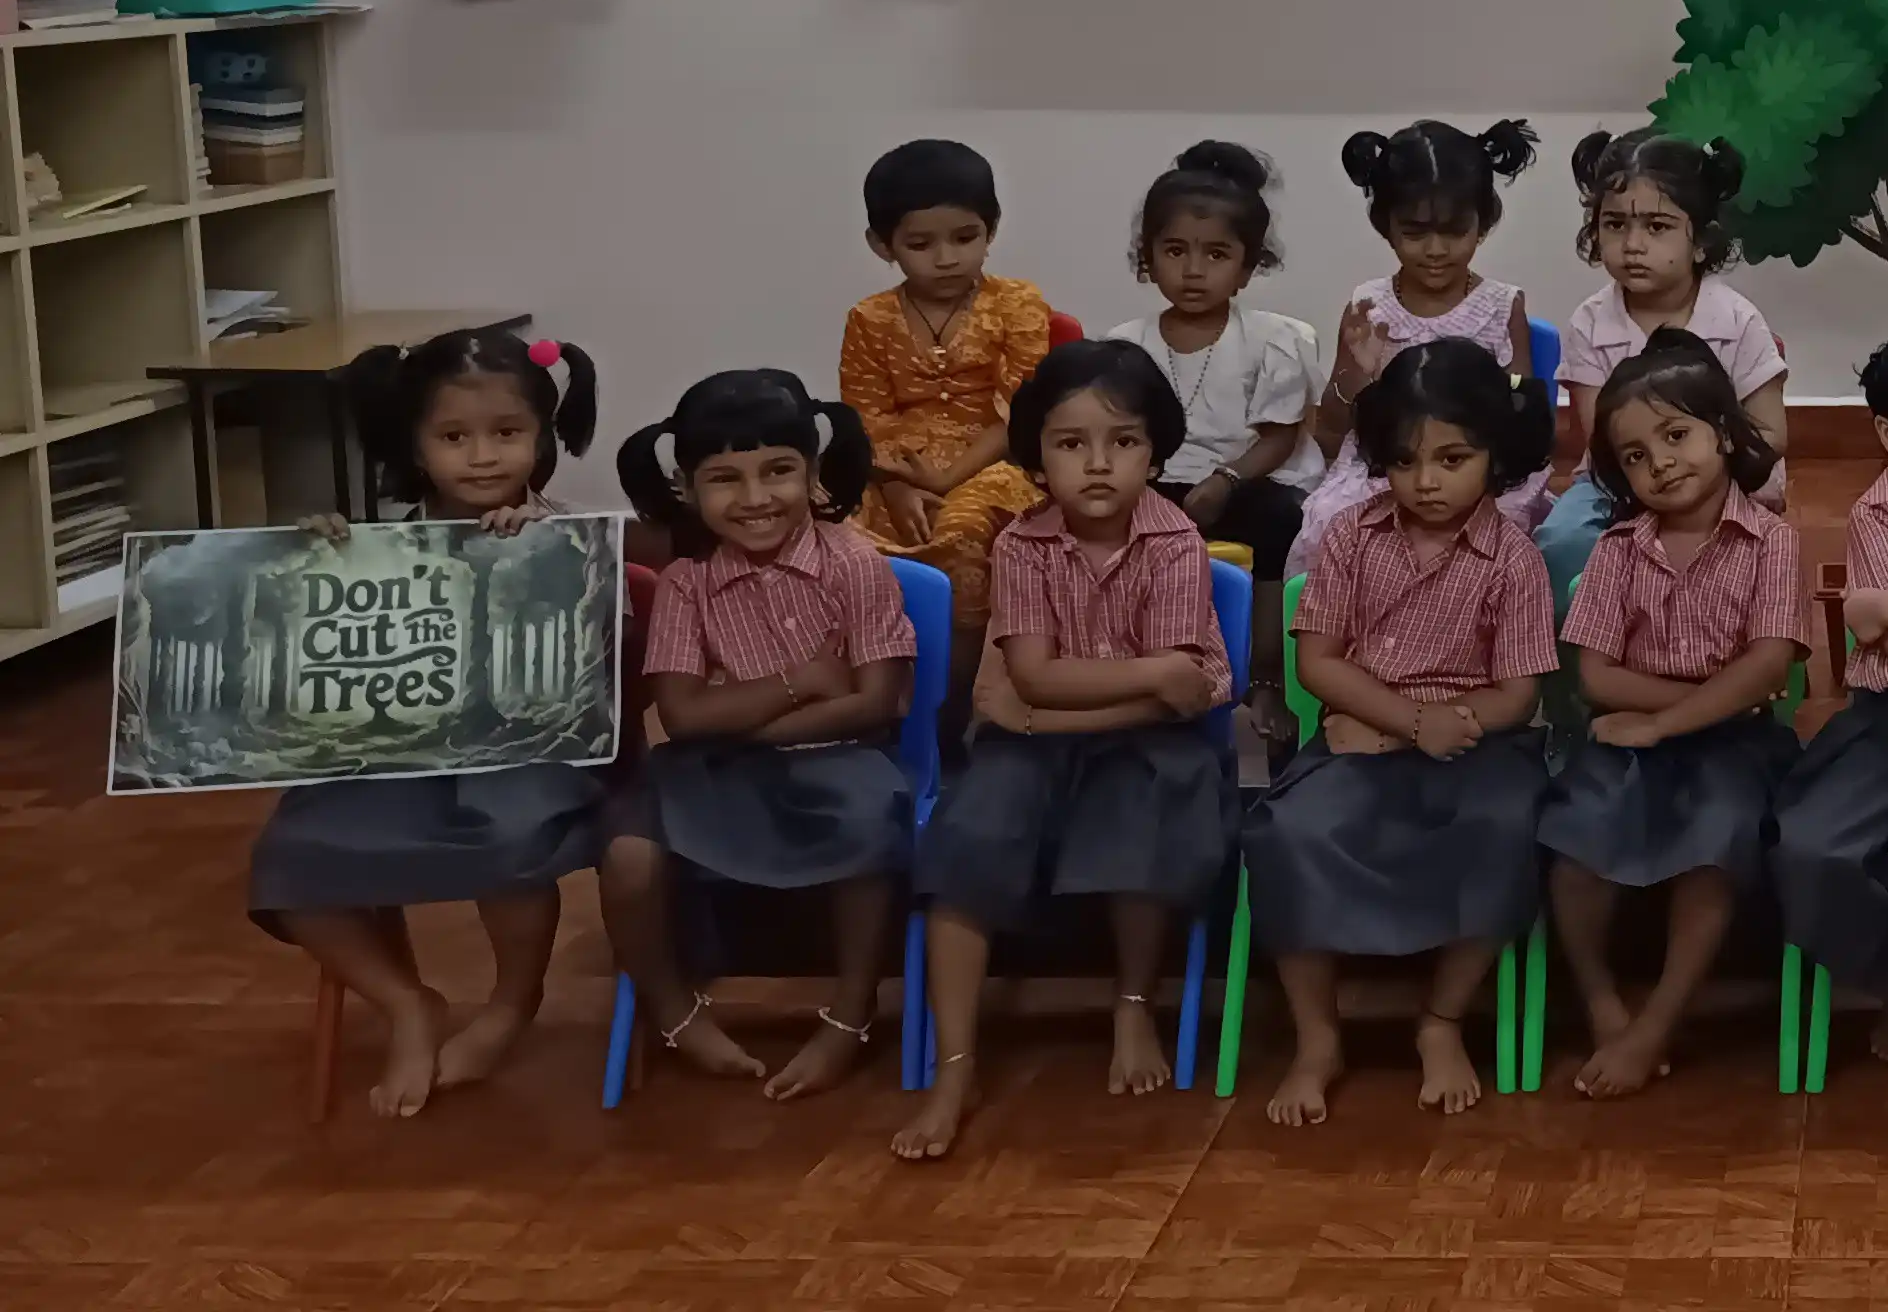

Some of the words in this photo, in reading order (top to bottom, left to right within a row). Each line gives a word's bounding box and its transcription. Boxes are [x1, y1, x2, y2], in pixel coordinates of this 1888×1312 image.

[302, 564, 451, 618] Don't
[302, 613, 397, 660] Cut
[300, 665, 456, 714] Trees
